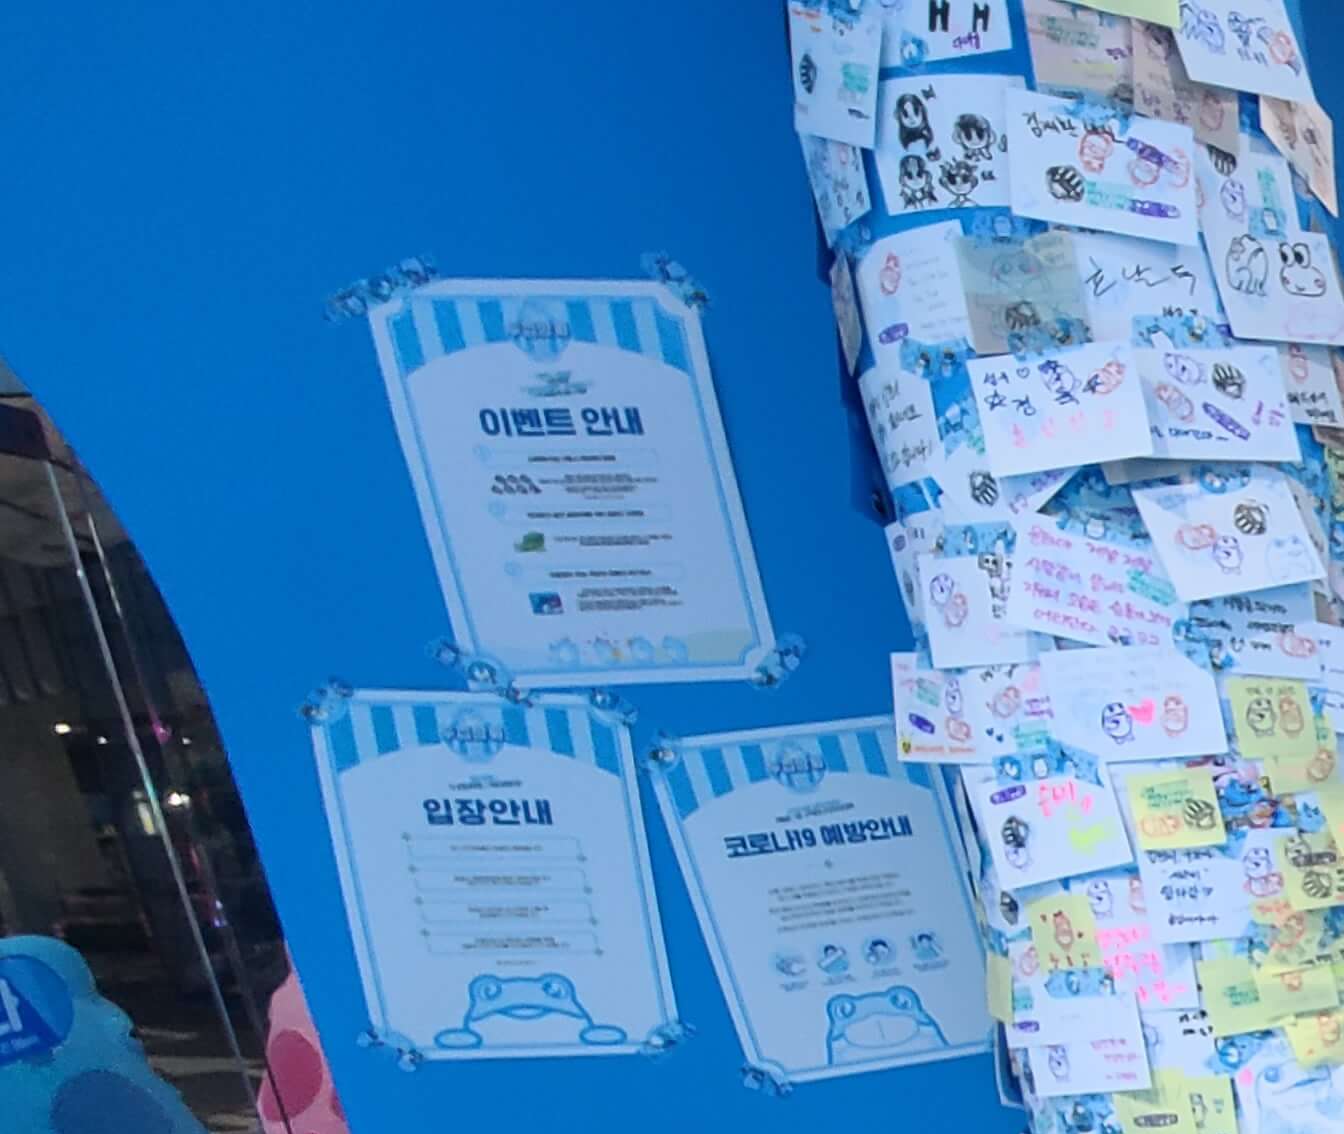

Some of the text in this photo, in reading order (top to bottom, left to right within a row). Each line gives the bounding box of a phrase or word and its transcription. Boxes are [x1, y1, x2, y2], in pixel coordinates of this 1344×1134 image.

[479, 406, 645, 437] 이벤트 안내
[422, 798, 553, 825] 입장안내
[723, 815, 913, 859] 코로나19 예방안내
